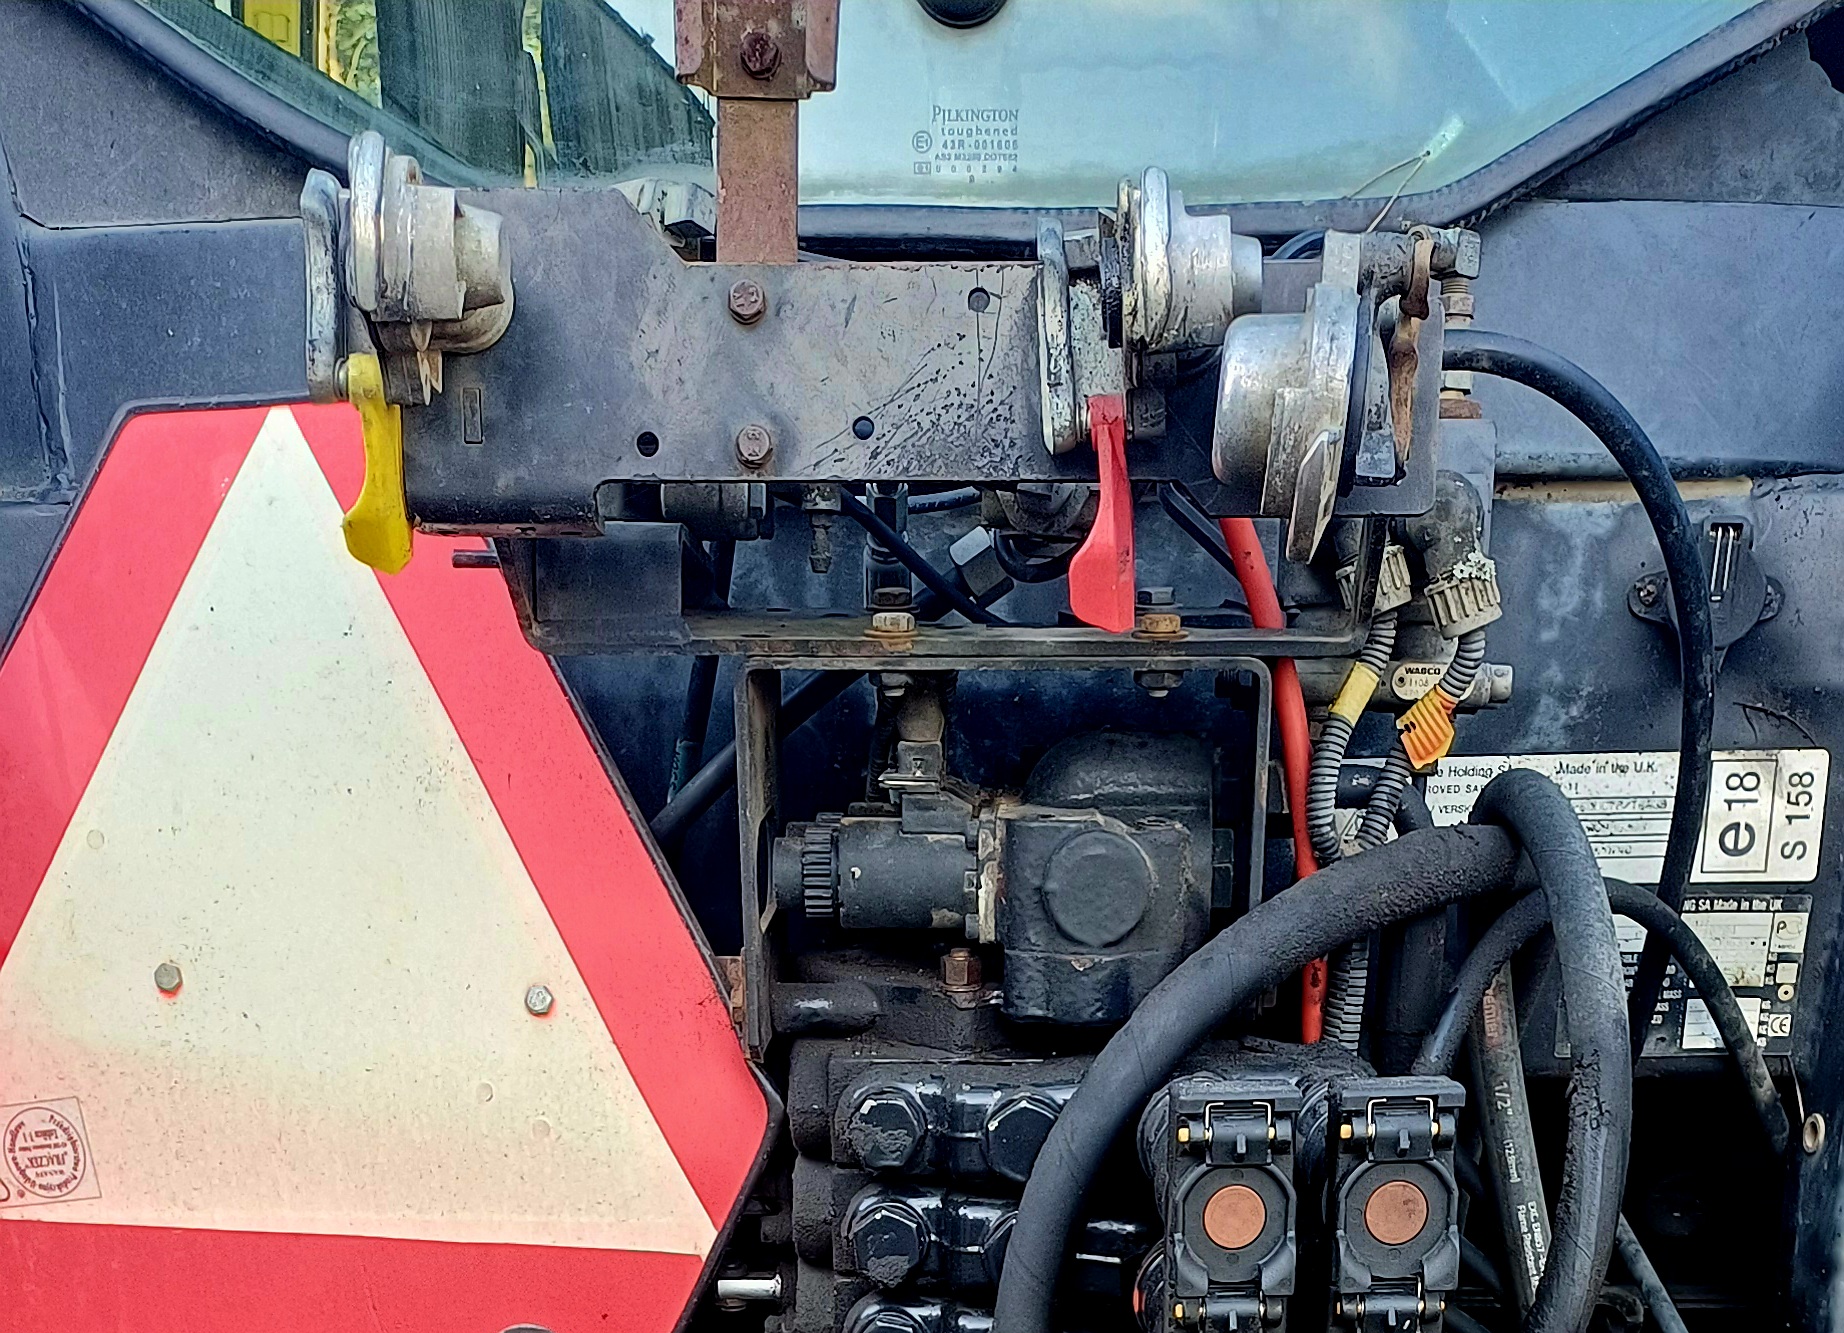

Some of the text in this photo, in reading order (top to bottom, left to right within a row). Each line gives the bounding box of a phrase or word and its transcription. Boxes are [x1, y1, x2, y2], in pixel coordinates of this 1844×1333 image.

[931, 104, 1019, 125] PILKINGTON
[941, 125, 1018, 138] toughened
[1404, 666, 1441, 675] WABCO
[1448, 766, 1493, 778] Holding
[1556, 761, 1591, 774] Made
[1595, 762, 1606, 774] in
[1634, 761, 1658, 773] U.K.
[1780, 771, 1815, 861] S 158
[1769, 899, 1784, 911] UK
